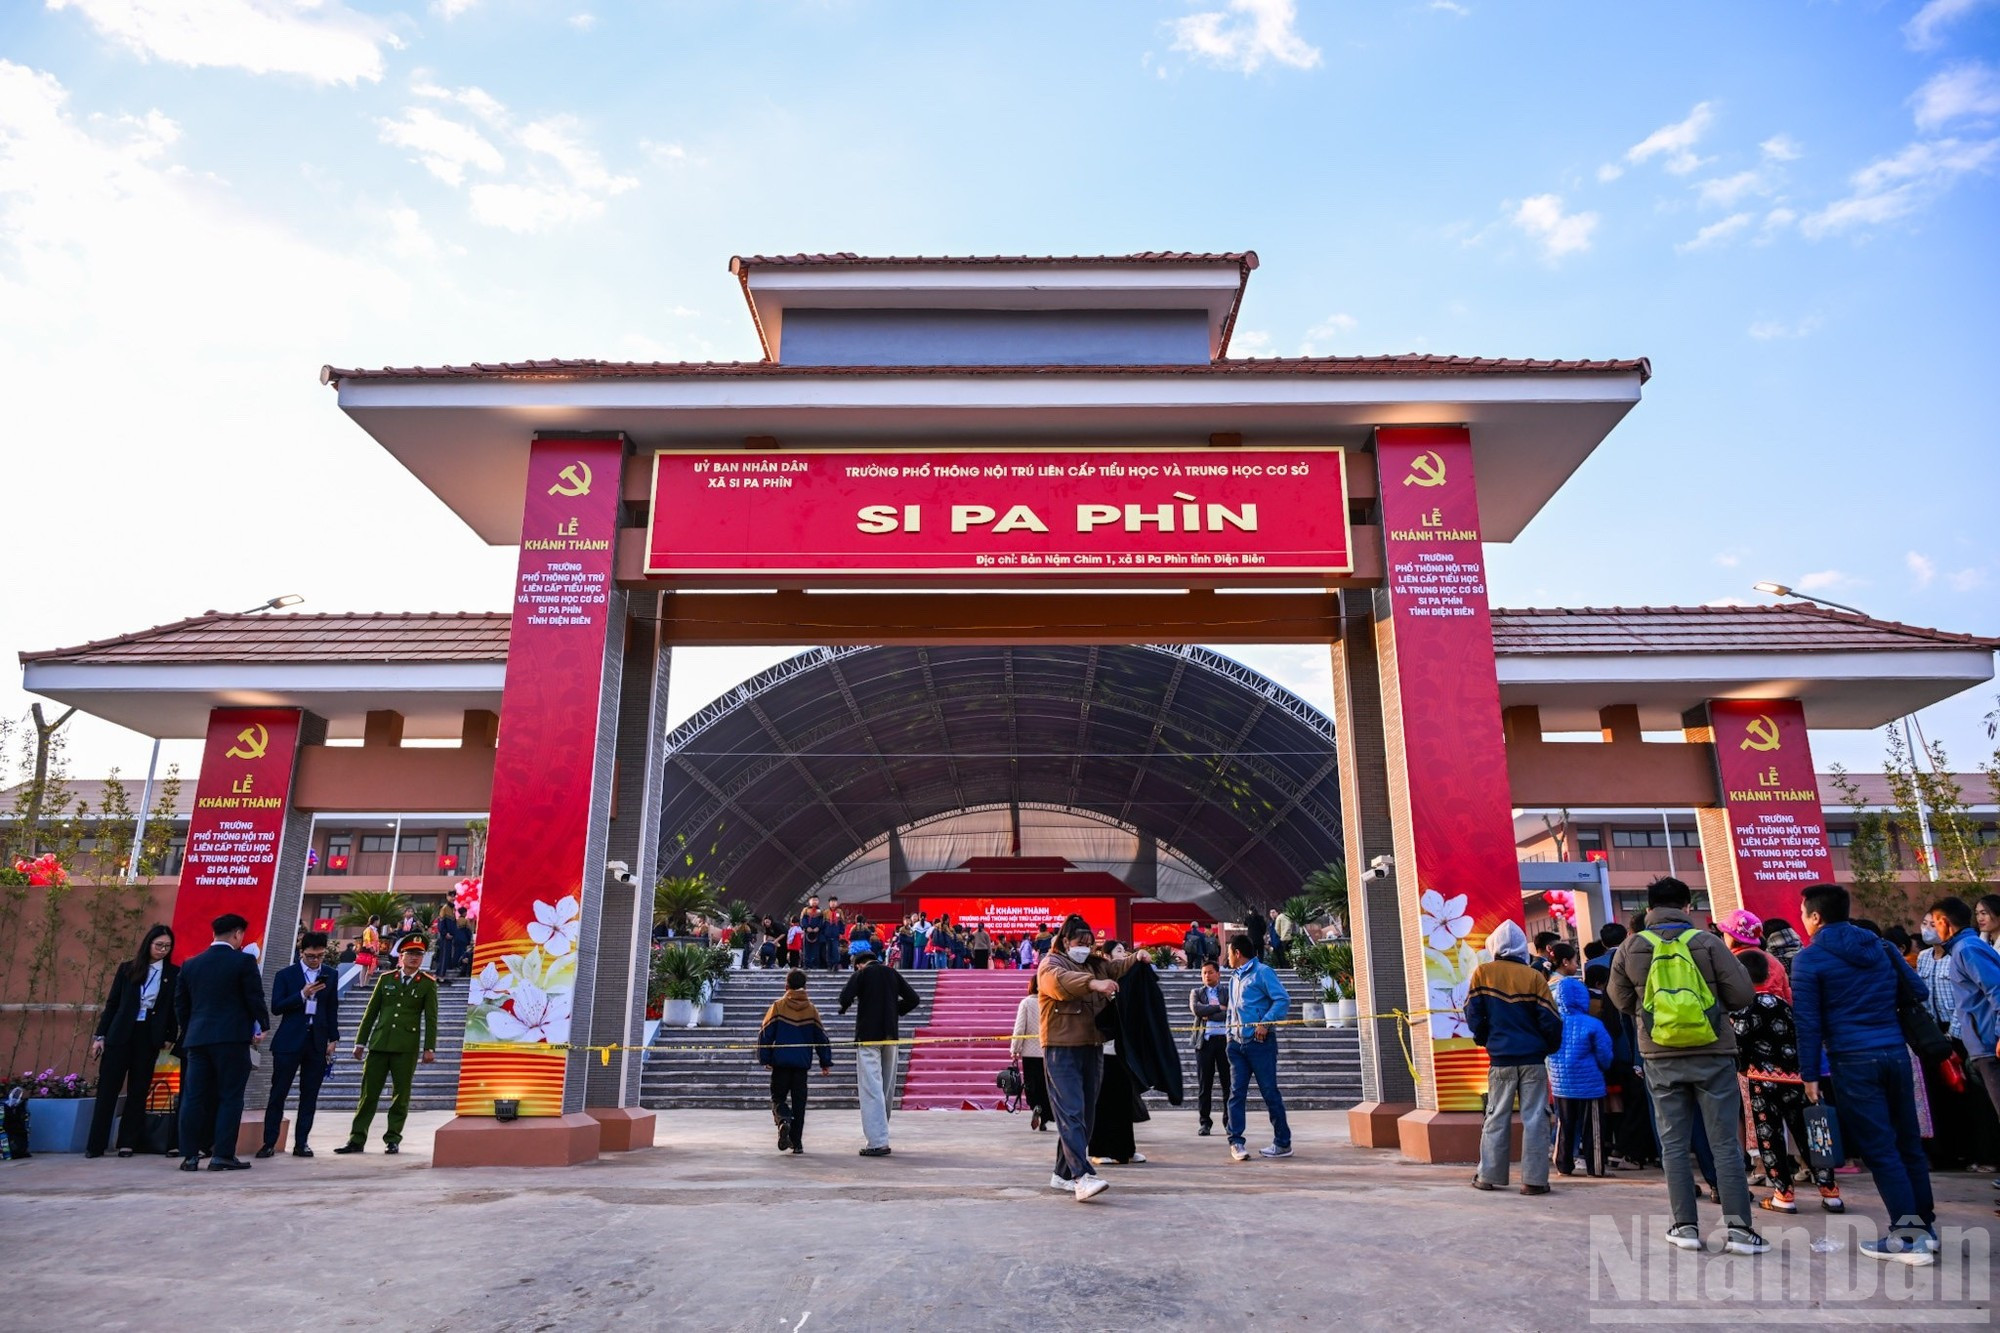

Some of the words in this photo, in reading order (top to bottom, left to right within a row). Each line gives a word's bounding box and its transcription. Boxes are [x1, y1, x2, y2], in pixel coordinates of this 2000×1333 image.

[714, 463, 739, 472] BAN
[743, 460, 777, 472] NHÂN
[781, 460, 808, 472] DÂN
[845, 463, 898, 477] TRƯỜNG
[902, 462, 930, 477] PHỔ
[934, 465, 980, 477] THÔNG
[984, 464, 1007, 479] NỘI
[1011, 464, 1034, 476] TRÚ
[1038, 465, 1063, 476] LIÊN
[1068, 462, 1095, 476] CẤP
[1100, 462, 1124, 476] TIỂU
[1129, 466, 1158, 479] HỌC
[1164, 463, 1181, 476] VÀ
[1185, 466, 1228, 476] TRUNG
[1233, 466, 1262, 478] HỌC
[1267, 464, 1287, 476] CƠ
[1291, 462, 1309, 476] SỞ
[708, 477, 726, 487] XÃ
[729, 478, 739, 487] SI
[744, 479, 759, 487] PA
[763, 476, 792, 487] PHÌN
[856, 505, 920, 533] SI
[951, 505, 1049, 532] PA
[1077, 491, 1257, 532] PHÌN
[1422, 508, 1442, 526] LỄ
[558, 517, 578, 536] LỄ
[1391, 529, 1433, 540] KHÁNH
[1436, 529, 1476, 540] THÀNH
[525, 538, 565, 550] KHÁNH
[569, 538, 608, 550] THÀNH
[976, 555, 994, 566] Địa
[998, 553, 1017, 564] chỉ:
[1021, 553, 1042, 564] Bản
[1045, 554, 1070, 566] Nậm
[1074, 555, 1102, 564] Chim
[1106, 555, 1115, 565] 1,
[1119, 554, 1132, 564] xã
[1148, 555, 1161, 563] Pa
[1164, 554, 1187, 563] Phìn
[1191, 553, 1210, 563] tỉnh
[1214, 554, 1238, 565] Điện
[1242, 554, 1265, 563] Biên
[1419, 553, 1454, 561] TRƯỜNG
[548, 562, 582, 571] TRƯỜNG
[1395, 562, 1412, 572] PHỔ
[1414, 563, 1444, 572] THÔNG
[1445, 563, 1460, 574] NỘI
[1462, 563, 1479, 572] TRÚ
[522, 571, 540, 581] PHỔ
[542, 573, 570, 581] THÔNG
[572, 573, 585, 583] NỘI
[588, 572, 604, 581] TRÚ
[1398, 574, 1418, 582] LIÊN
[1420, 573, 1438, 582] CẤP
[1440, 572, 1459, 582] TIỂU
[1461, 575, 1478, 584] HỌC
[544, 582, 562, 592] CẤP
[564, 582, 582, 592] TIỂU
[584, 585, 601, 594] HỌC
[1395, 585, 1407, 594] VÀ
[1440, 586, 1457, 595] HỌC
[518, 594, 529, 603] VÀ
[561, 596, 578, 605] HỌC
[1442, 596, 1462, 604] PHÌN
[561, 605, 582, 613] PHÌN
[1432, 607, 1452, 617] ĐIỆN
[1454, 607, 1474, 615] BIÊN
[549, 616, 569, 626] ĐIỆN
[571, 616, 590, 624] BIÊN
[1759, 767, 1780, 786] LỄ
[232, 775, 253, 793] LỄ
[1730, 789, 1771, 801] KHÁNH
[1774, 789, 1815, 801] THÀNH
[199, 796, 239, 808] KHÁNH
[242, 796, 281, 808] THÀNH
[1759, 814, 1794, 823] TRƯỜNG
[220, 820, 253, 829] TRƯỜNG
[1737, 824, 1754, 834] PHỔ
[1756, 826, 1785, 834] THÔNG
[1787, 826, 1801, 836] NỘI
[1802, 825, 1820, 834] TRÚ
[194, 830, 212, 840] PHỔ
[213, 832, 240, 840] THÔNG
[242, 832, 256, 842] NỘI
[258, 831, 274, 840] TRÚ
[1741, 837, 1760, 846] LIÊN
[1762, 836, 1780, 846] CẤP
[1782, 835, 1801, 845] TIỂU
[1803, 838, 1820, 847] HỌC
[194, 843, 213, 851] LIÊN
[214, 842, 232, 851] CẤP
[234, 841, 252, 851] TIỂU
[253, 844, 270, 853] HỌC
[1739, 848, 1750, 857] VÀ
[1783, 849, 1800, 858] HỌC
[188, 854, 198, 862] VÀ
[230, 855, 247, 864] HỌC
[1786, 859, 1806, 868] PHÌN
[230, 865, 250, 873] PHÌN
[217, 876, 236, 887] ĐIỆN
[238, 876, 258, 885] BIÊN
[1777, 871, 1797, 882] ĐIỆN
[1799, 871, 1819, 880] BIÊN
[985, 904, 995, 914] LỄ
